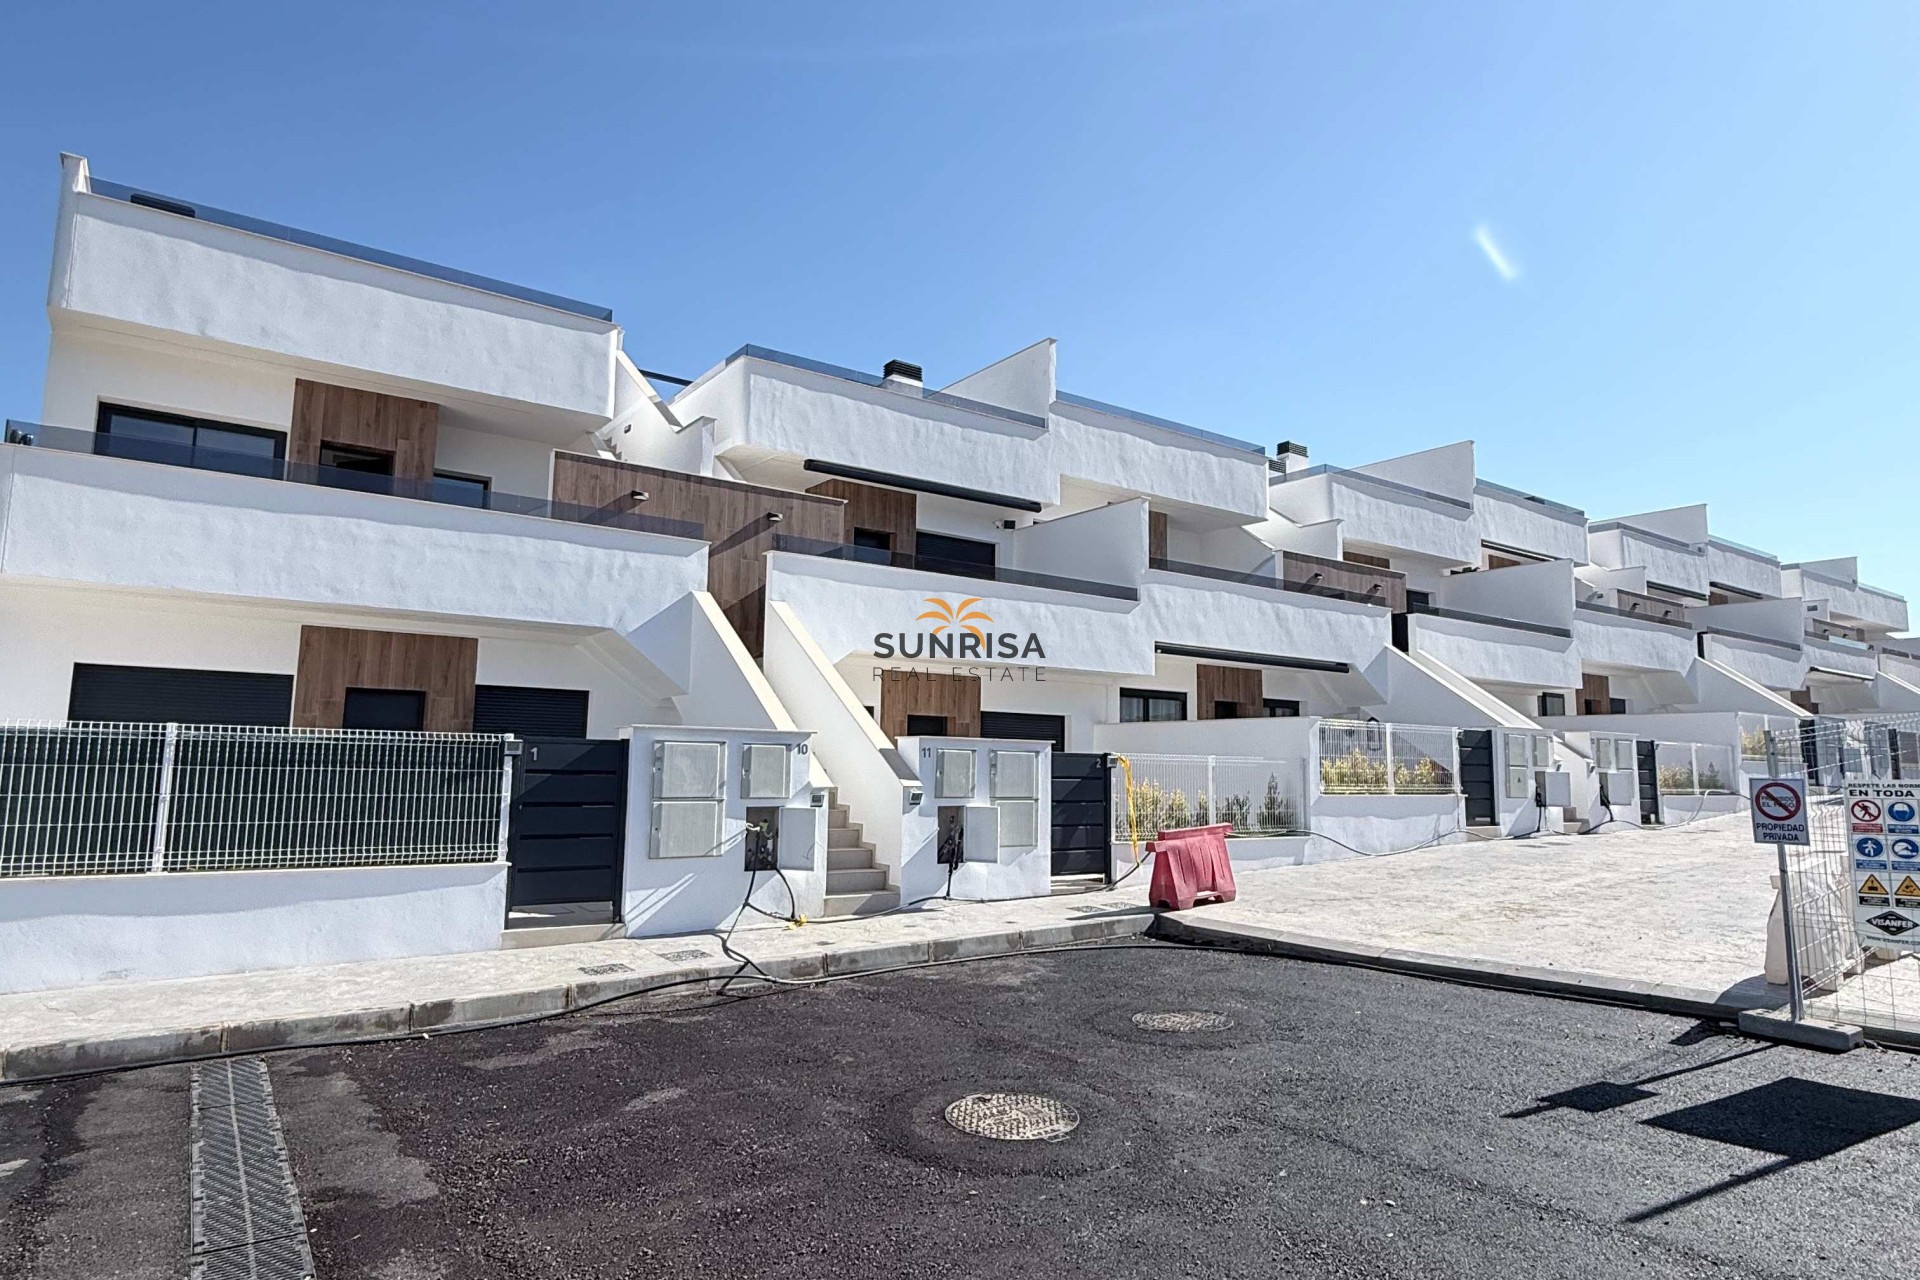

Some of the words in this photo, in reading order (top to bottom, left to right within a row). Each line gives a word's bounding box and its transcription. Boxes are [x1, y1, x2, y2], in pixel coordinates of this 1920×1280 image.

[530, 747, 538, 761] 1
[796, 743, 808, 755] 10
[921, 747, 931, 758] 11
[1095, 757, 1102, 769] 2
[1849, 789, 1869, 797] EN
[1873, 789, 1915, 797] TODA
[1756, 823, 1804, 832] PROPIEDAD
[1763, 832, 1800, 841] PRIVADA
[1870, 918, 1914, 928] VISANFER
